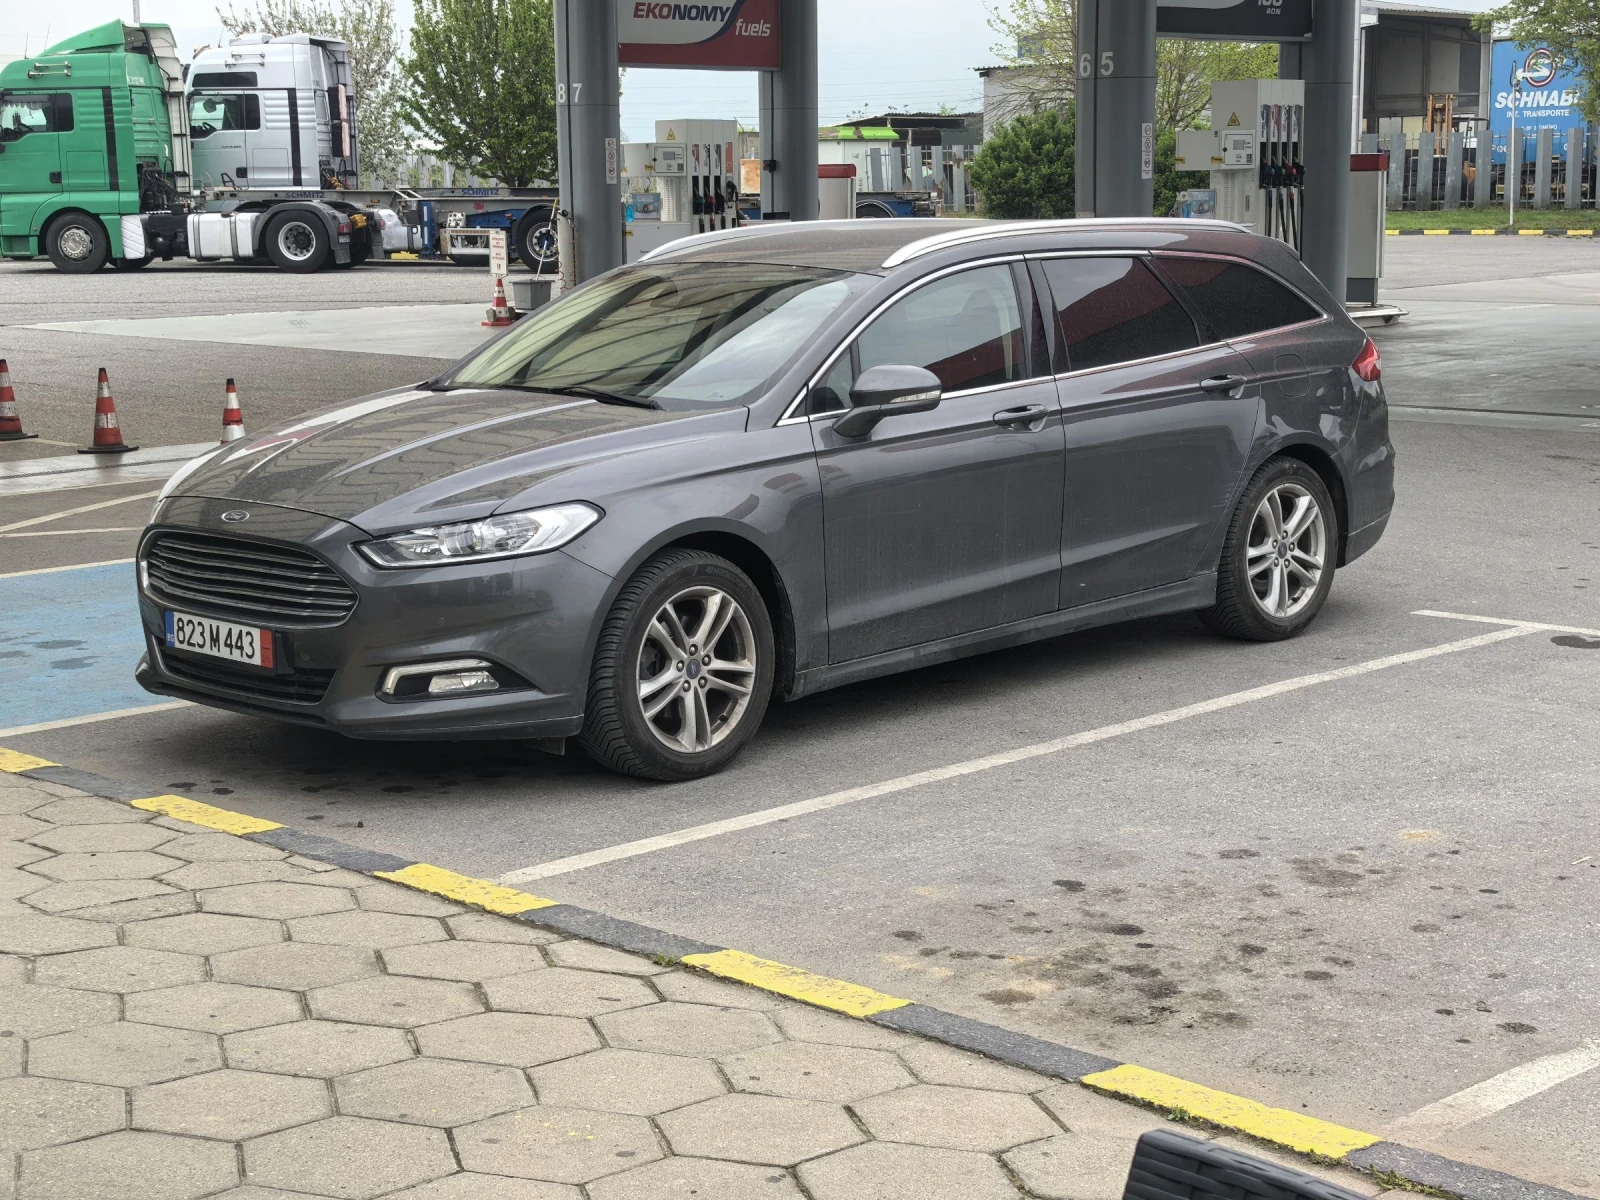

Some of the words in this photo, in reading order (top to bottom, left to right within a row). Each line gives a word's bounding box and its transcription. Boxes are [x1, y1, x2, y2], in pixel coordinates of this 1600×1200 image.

[633, 2, 732, 22] EKONOMY
[1266, 7, 1281, 15] RON
[735, 19, 771, 36] fuels
[1079, 53, 1091, 77] 6
[1100, 51, 1114, 76] 5
[557, 83, 566, 104] 8
[572, 83, 583, 103] 7
[1522, 109, 1570, 117] TRANSPORTE
[285, 191, 325, 199] SCHMITZ
[461, 188, 499, 196] SCHMITZ
